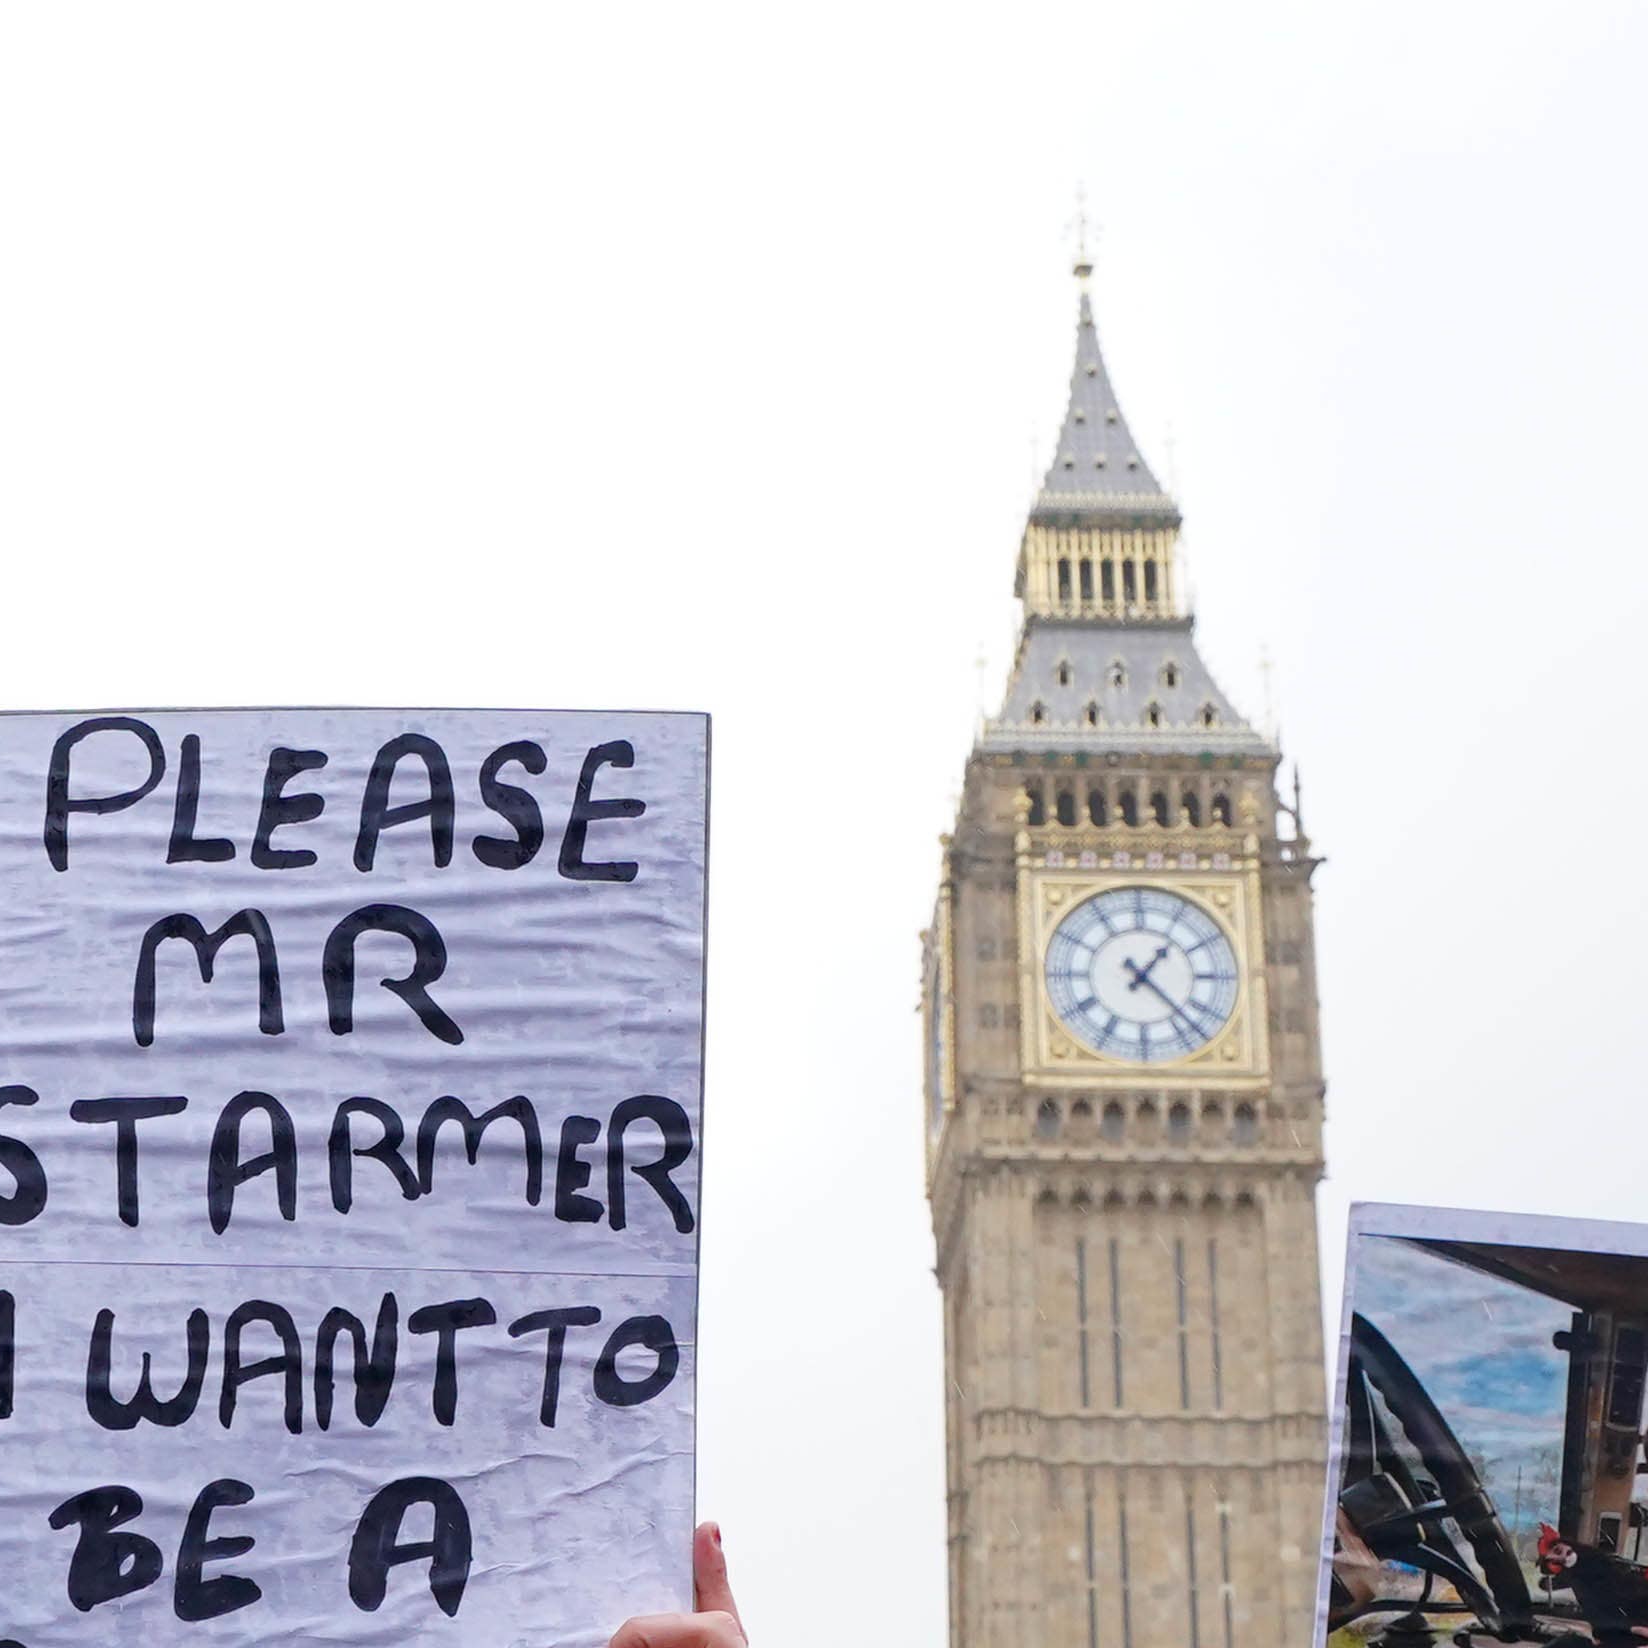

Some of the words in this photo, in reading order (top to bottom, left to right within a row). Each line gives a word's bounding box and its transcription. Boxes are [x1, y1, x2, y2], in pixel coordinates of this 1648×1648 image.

[44, 717, 647, 882] PLEASE
[133, 904, 465, 1047] MR
[85, 1292, 497, 1434] WANT
[508, 1305, 680, 1428] TO
[47, 1478, 262, 1622] BE
[348, 1476, 473, 1618] A
